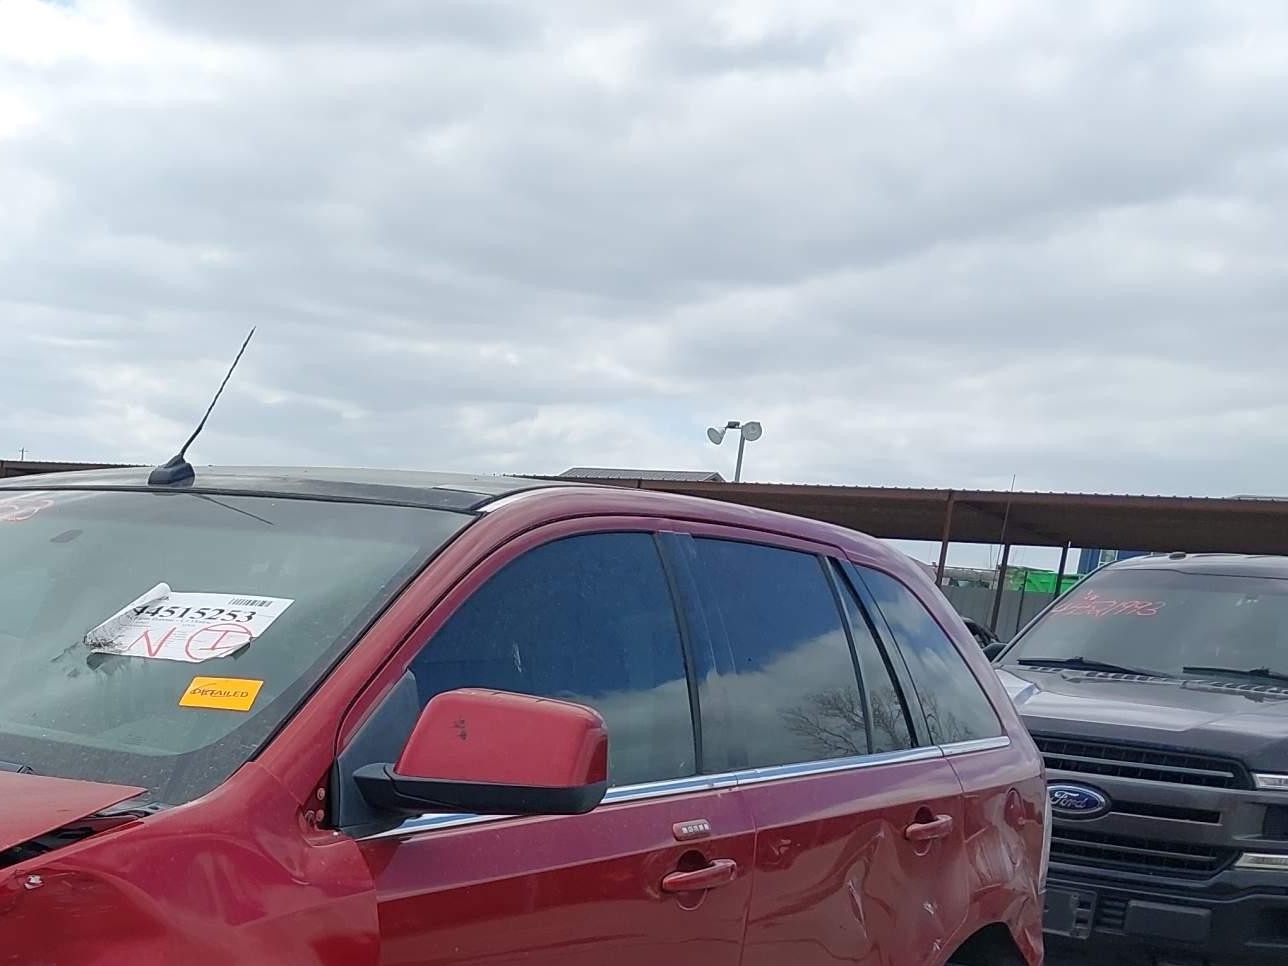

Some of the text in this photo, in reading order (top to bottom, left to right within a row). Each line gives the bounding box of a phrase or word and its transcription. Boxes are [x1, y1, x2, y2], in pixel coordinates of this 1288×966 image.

[133, 604, 257, 623] 44515253
[128, 626, 177, 657] N
[1050, 790, 1088, 809] Ford
